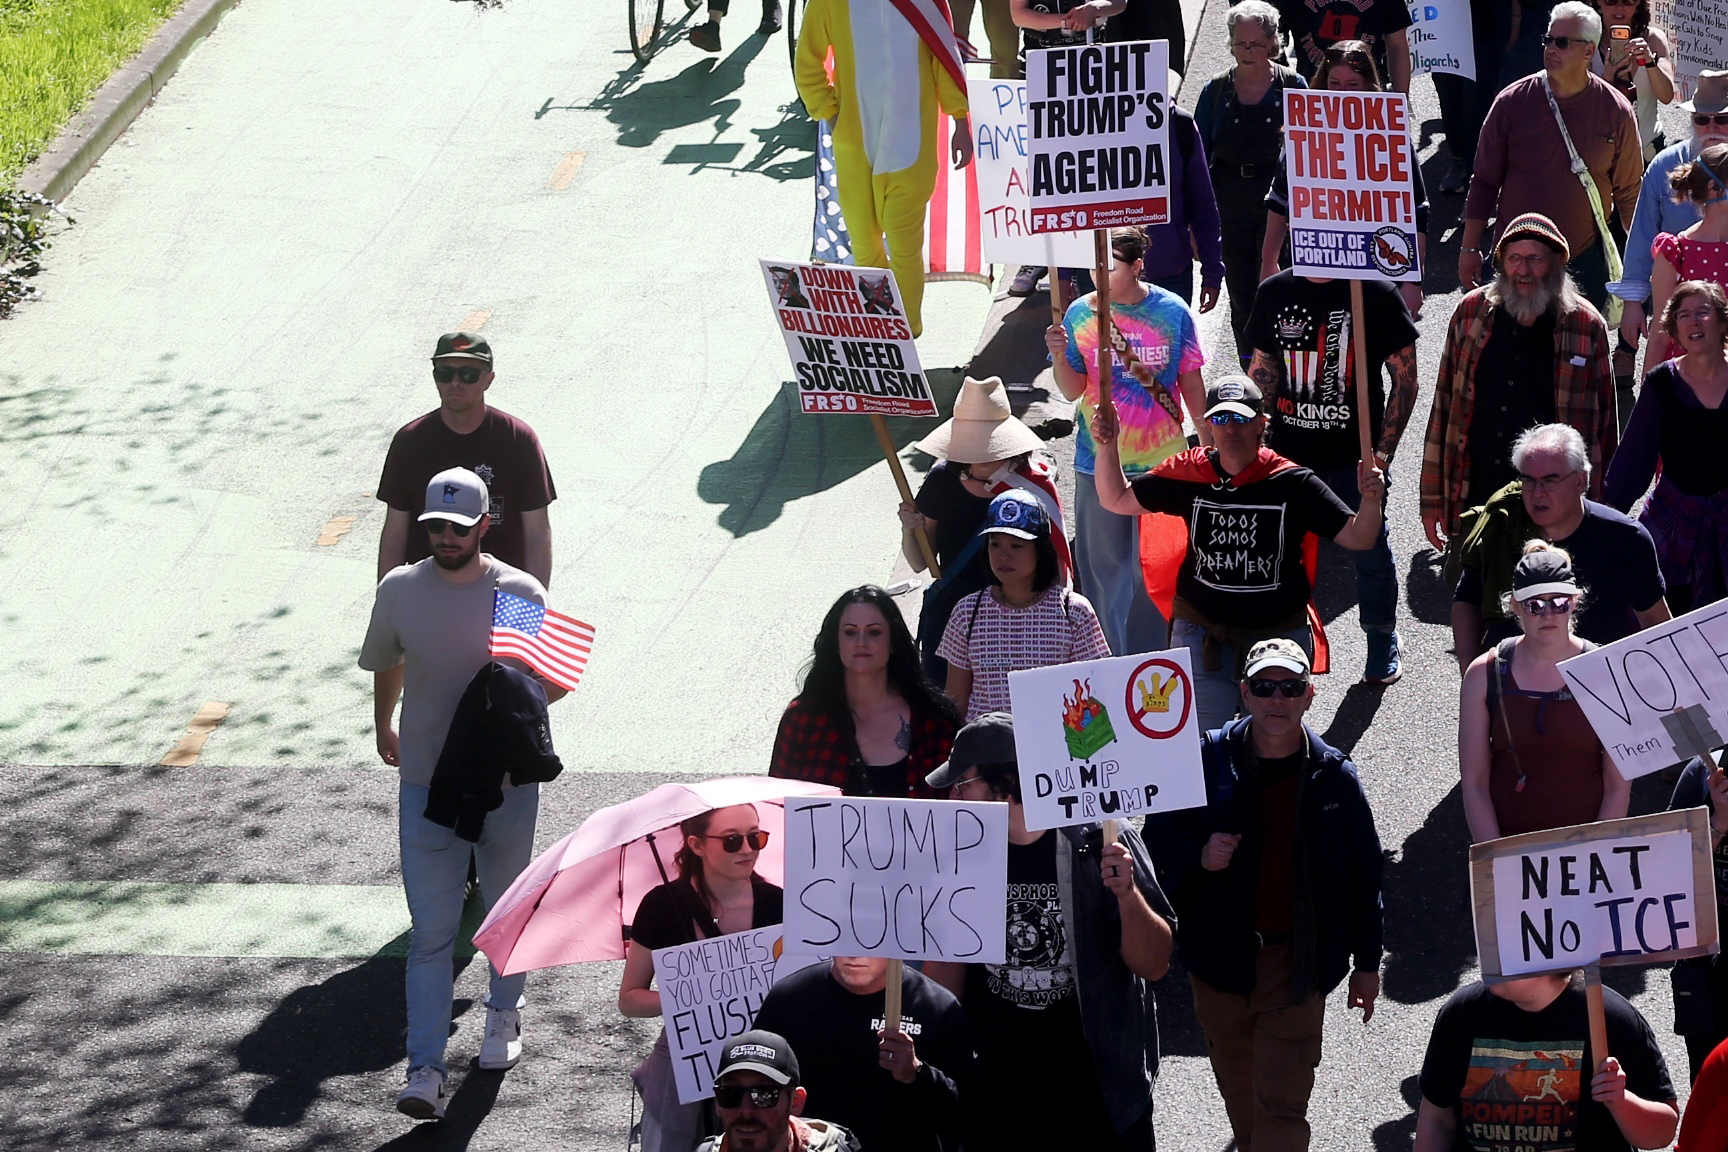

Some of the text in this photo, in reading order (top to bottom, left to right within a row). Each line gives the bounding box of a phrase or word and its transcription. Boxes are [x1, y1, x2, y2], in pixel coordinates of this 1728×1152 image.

[1698, 0, 1712, 14] Due
[1694, 38, 1713, 56] Kids
[1046, 42, 1150, 98] FIGHT
[1030, 92, 1164, 139] TRUMP'S
[1288, 93, 1406, 131] REVOKE
[1032, 144, 1166, 197] AGENDA
[1289, 130, 1408, 182] THE ICE
[1034, 210, 1088, 231] FRSO
[1093, 209, 1124, 218] Freedom
[1093, 213, 1166, 226] Socialist Organization
[1292, 186, 1412, 224] PERMIT!
[1294, 230, 1366, 250] ICE OUT OF
[1295, 247, 1367, 267] PORTLAND
[800, 266, 856, 290] DOWN
[808, 289, 864, 314] WITH
[778, 309, 911, 341] BILLIONAIRES
[798, 336, 905, 370] WE NEED
[796, 362, 928, 399] SOCIALISM
[1320, 358, 1340, 404] People
[804, 395, 910, 410] FRSO Freedom Road
[863, 404, 934, 415] Socialist Organization
[1276, 398, 1350, 420] NO KINGS
[1282, 415, 1338, 430] OCTOBER 18TH
[1208, 511, 1258, 530] TODOS
[1208, 530, 1258, 548] SOMOS
[1198, 549, 1275, 580] DREAMERS
[1612, 736, 1662, 766] Them
[1035, 760, 1121, 799] DUMP
[1058, 784, 1159, 819] TRUMP
[794, 802, 985, 876] TRUMP
[1522, 844, 1650, 899] NEAT
[799, 879, 984, 958] SUCKS
[1594, 892, 1690, 958] ICE
[662, 932, 770, 982] SOMETIMES
[666, 978, 703, 1011] YOU
[1473, 1124, 1558, 1142] FUN RUN
